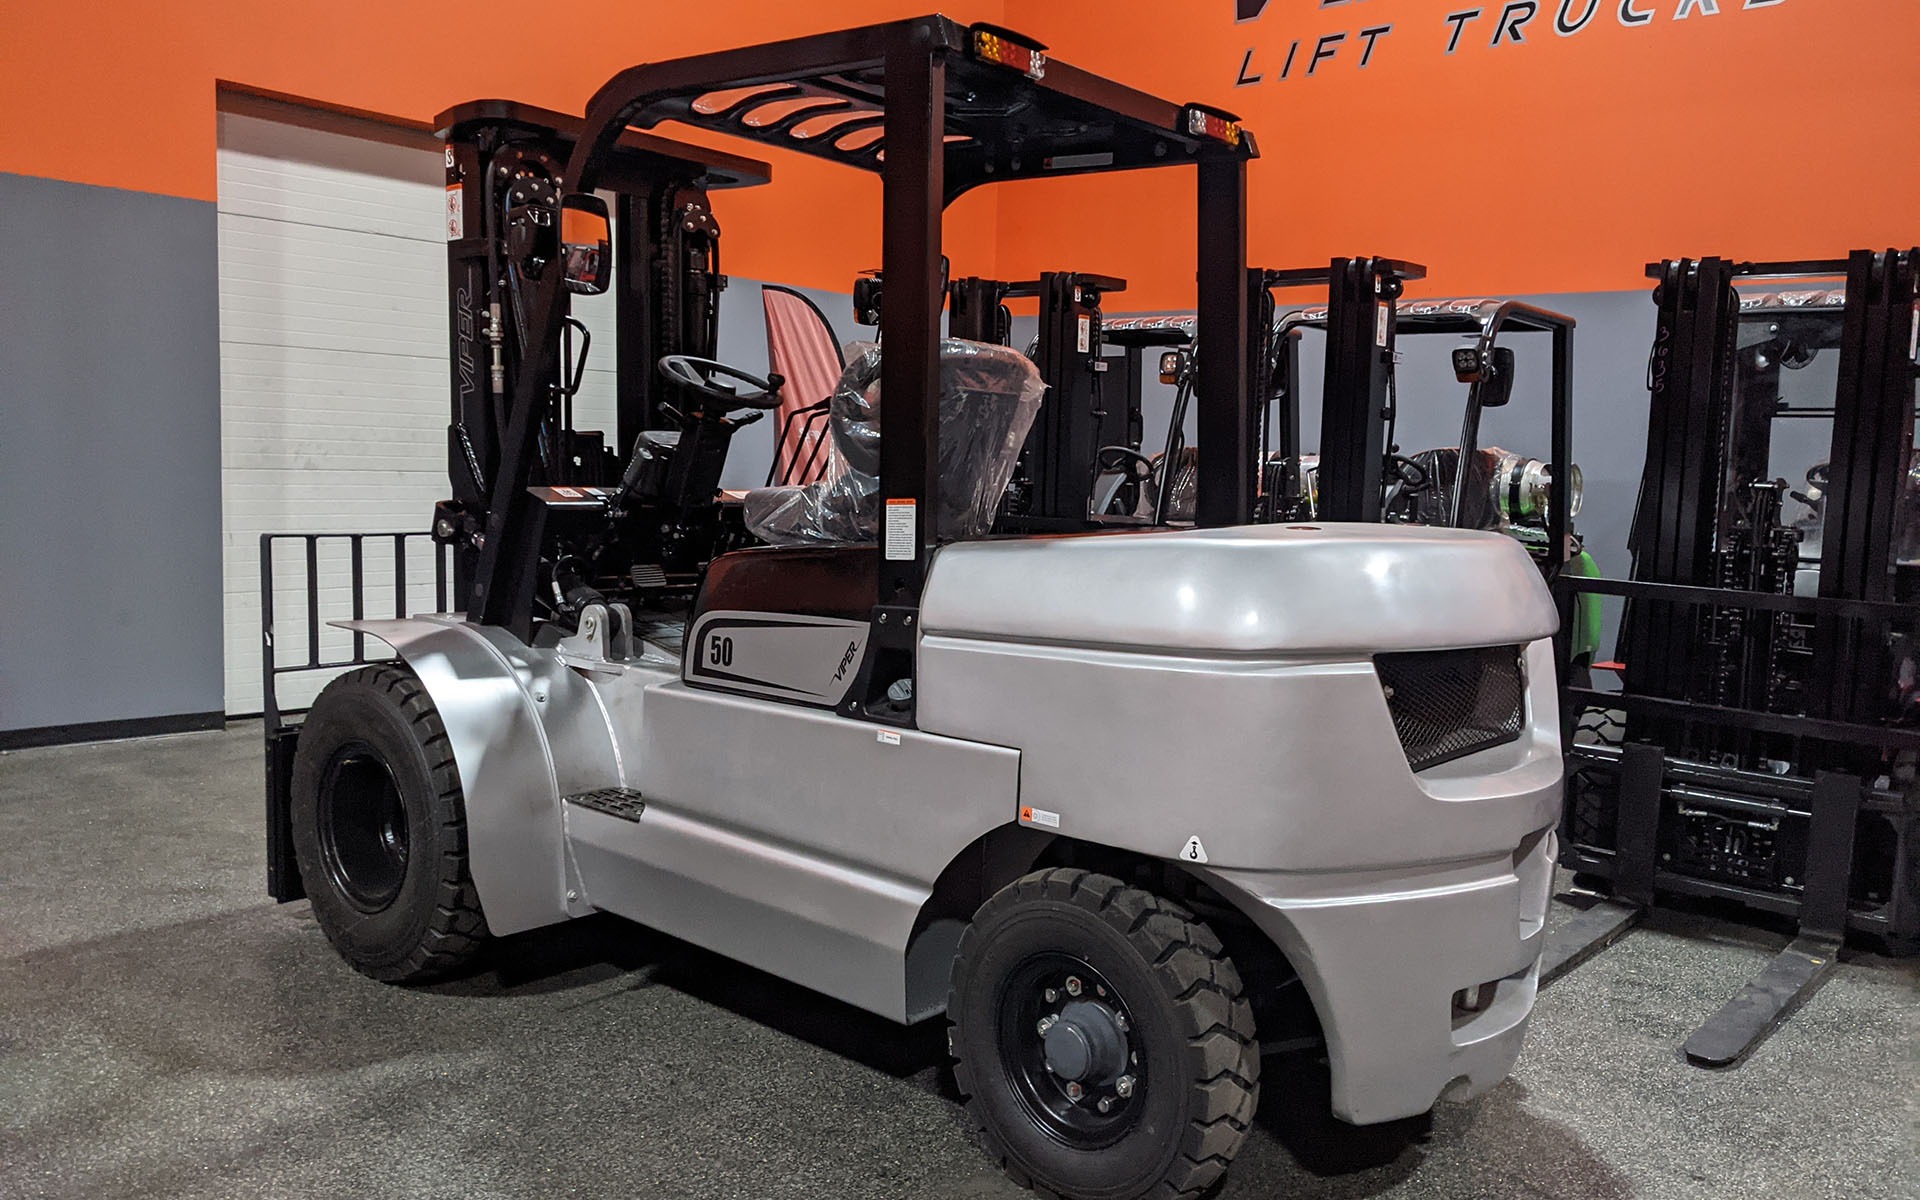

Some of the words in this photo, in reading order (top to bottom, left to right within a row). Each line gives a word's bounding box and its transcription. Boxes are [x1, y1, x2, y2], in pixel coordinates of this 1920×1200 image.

[1234, 23, 1394, 88] LIFT
[1443, 0, 1787, 56] TRUC
[457, 283, 475, 397] VIPER
[710, 635, 733, 667] 50
[832, 640, 859, 684] VIPER
